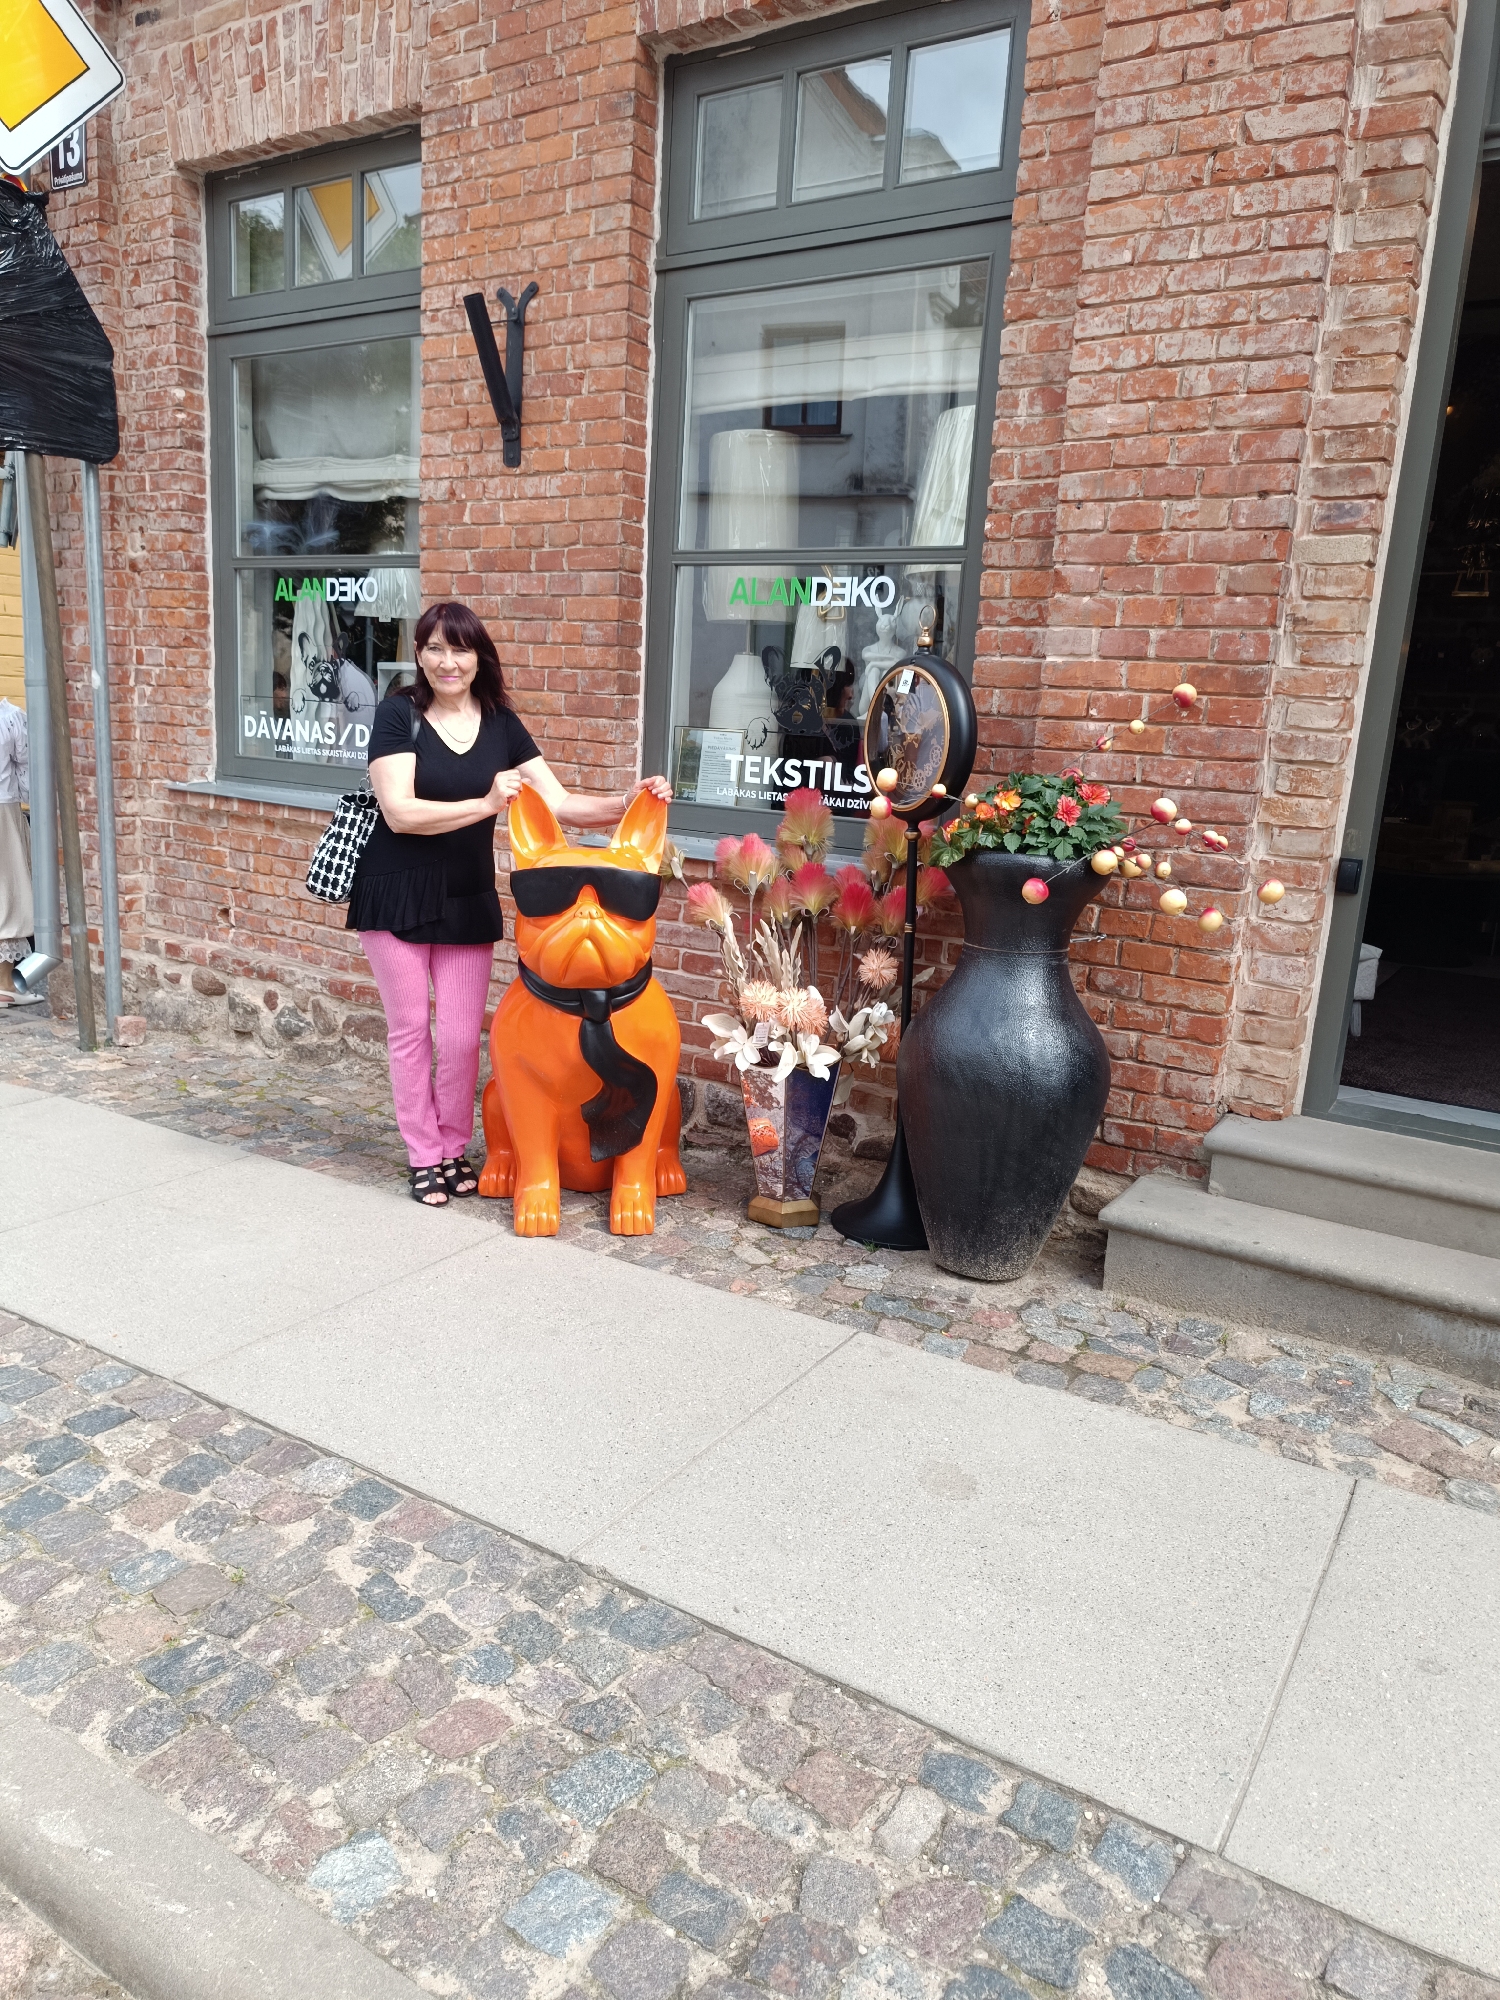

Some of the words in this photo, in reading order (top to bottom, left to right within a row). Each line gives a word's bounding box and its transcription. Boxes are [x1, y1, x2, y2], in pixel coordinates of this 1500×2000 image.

[243, 711, 371, 748] DĀVANAS/D
[274, 744, 301, 754] LABĀKAS
[301, 747, 321, 756] LIETAS
[321, 749, 357, 760] SKAISTĀKAI
[357, 750, 369, 760] DZĪ
[716, 786, 757, 799] LABĀKAS
[758, 790, 789, 802] LIETAS
